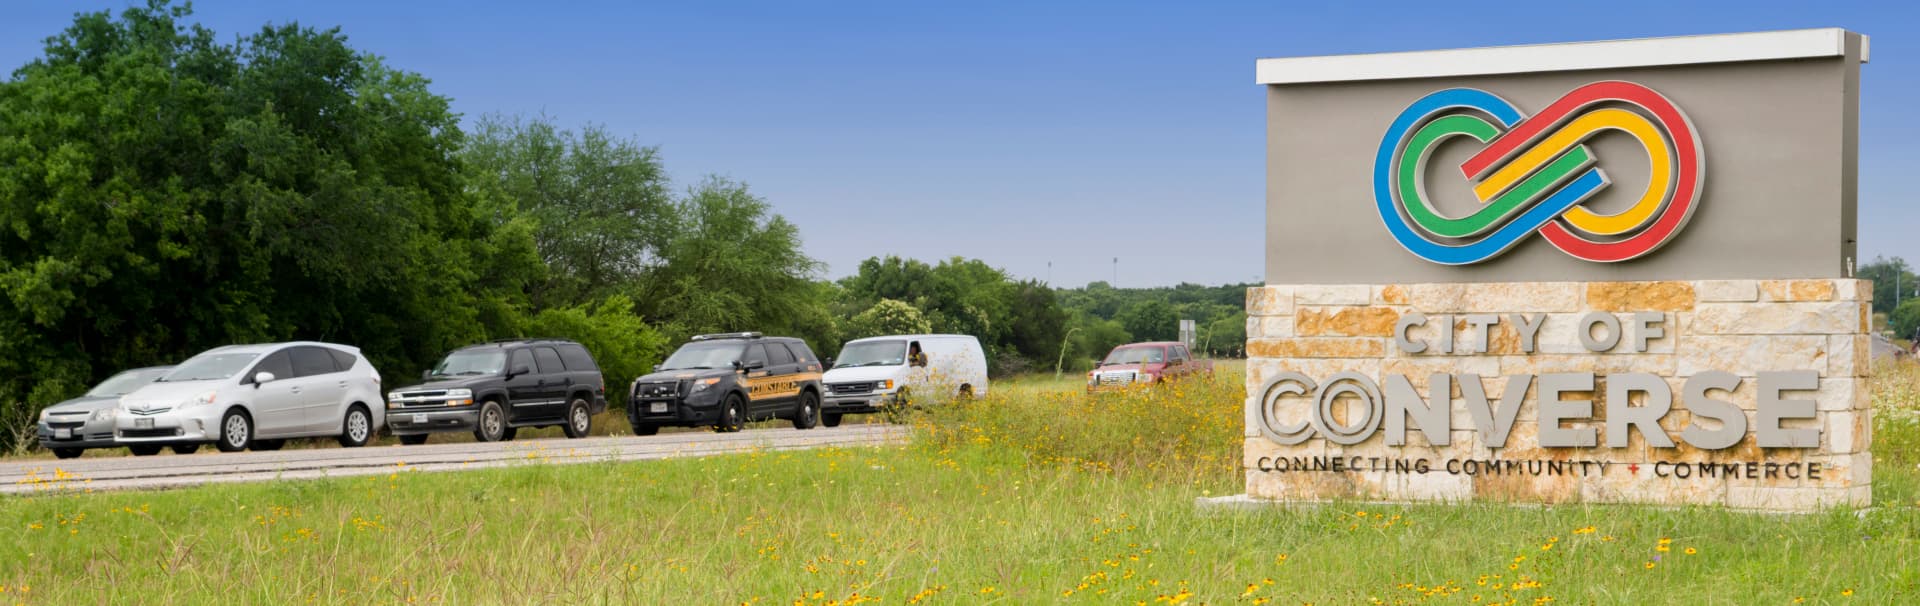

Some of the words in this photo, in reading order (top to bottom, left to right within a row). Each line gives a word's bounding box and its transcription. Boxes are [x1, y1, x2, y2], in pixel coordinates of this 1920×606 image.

[1396, 313, 1545, 353] CITY
[1579, 312, 1665, 351] OF
[1256, 370, 1820, 449] CONVERSE
[1258, 456, 1429, 474] CONNECTING
[1446, 459, 1611, 477] COMMUNITY
[1654, 461, 1821, 480] COMMERCE
